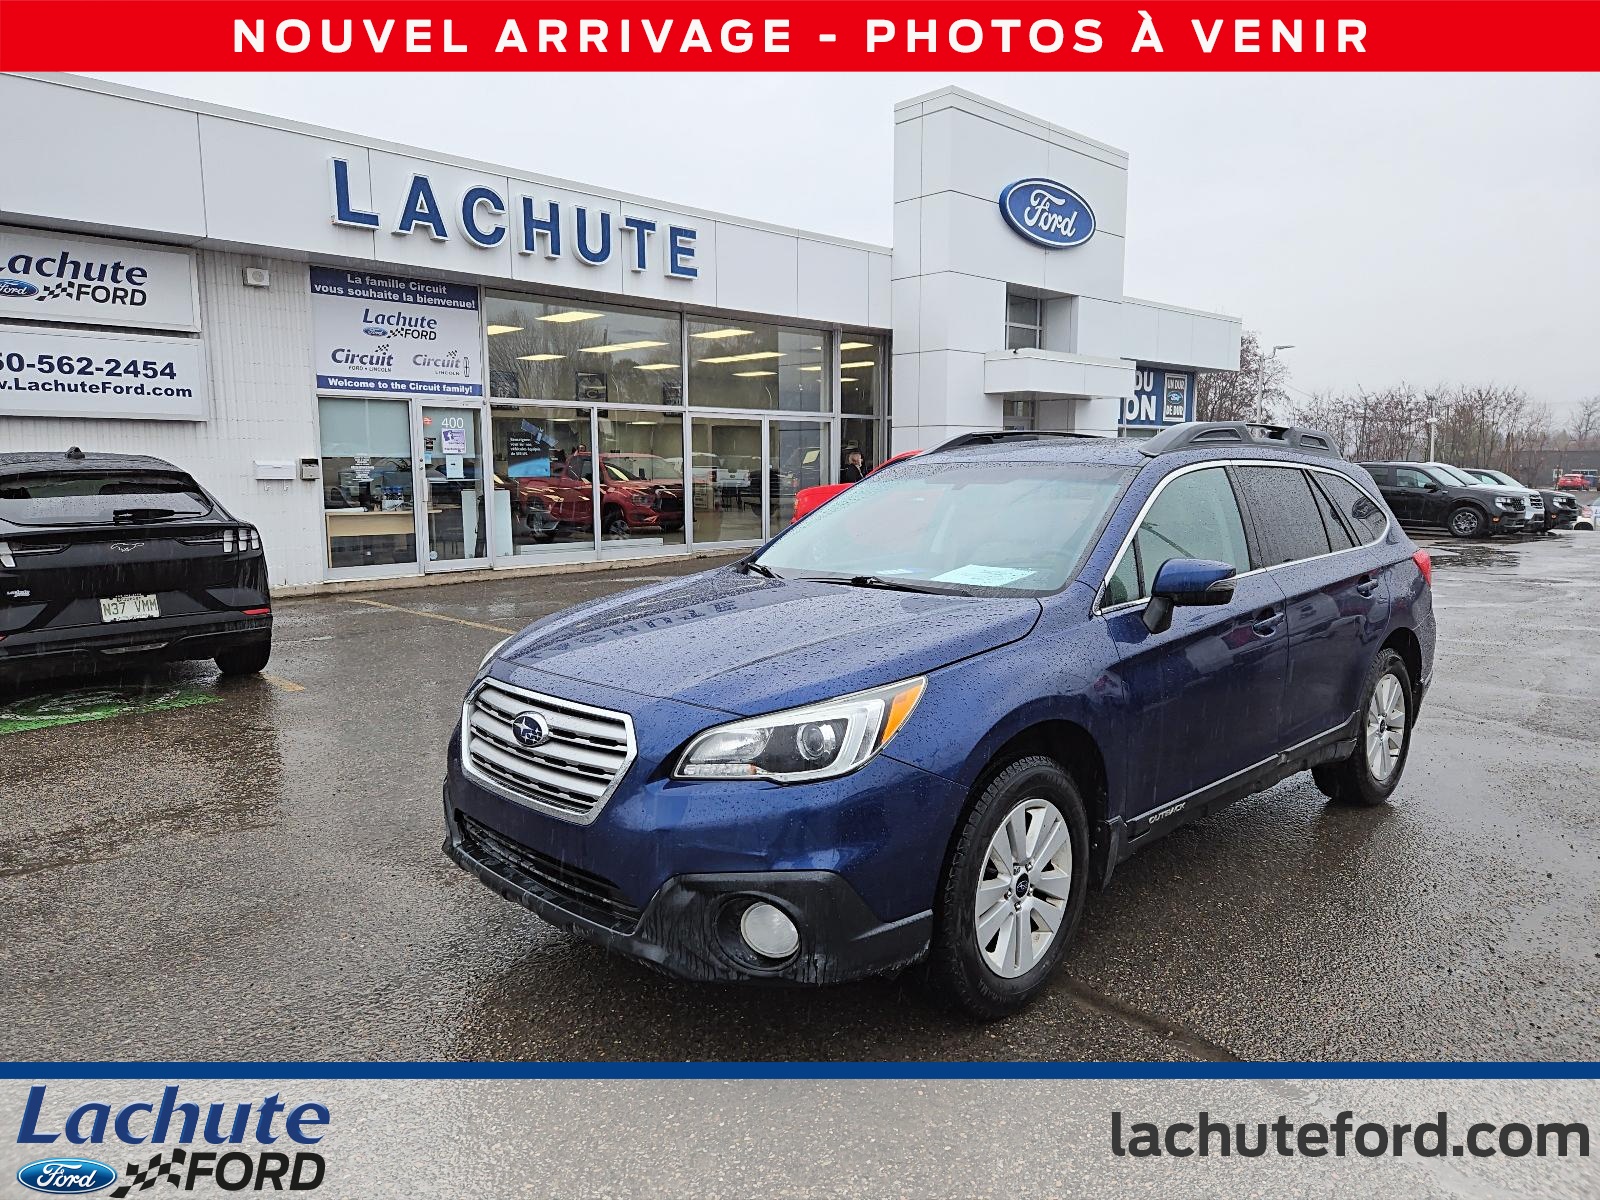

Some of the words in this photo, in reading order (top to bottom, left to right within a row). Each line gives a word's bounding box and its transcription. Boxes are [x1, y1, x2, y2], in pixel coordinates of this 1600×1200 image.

[329, 157, 699, 280] LACHUTE
[1023, 189, 1078, 238] Ford
[0, 251, 148, 287] achute
[75, 284, 147, 306] FORD
[346, 273, 362, 285] La
[365, 276, 406, 290] famille
[409, 281, 447, 295] Circuit
[313, 284, 344, 295] vous
[347, 288, 400, 301] souhaite
[402, 292, 414, 302] la
[416, 293, 475, 309] bienvenue!
[362, 308, 438, 330] Lachute
[404, 328, 437, 341] FORD
[0, 352, 177, 380] 0-562-2454
[331, 348, 394, 367] Circuit
[412, 353, 460, 369] Circuit
[328, 377, 375, 389] Welcome
[377, 381, 389, 389] to
[390, 382, 407, 390] the
[409, 382, 441, 392] Circuit
[442, 384, 473, 395] family!
[441, 417, 464, 429] 400
[102, 601, 125, 616] N37
[134, 598, 158, 613] VMM
[1148, 801, 1186, 825] OUTBACK
